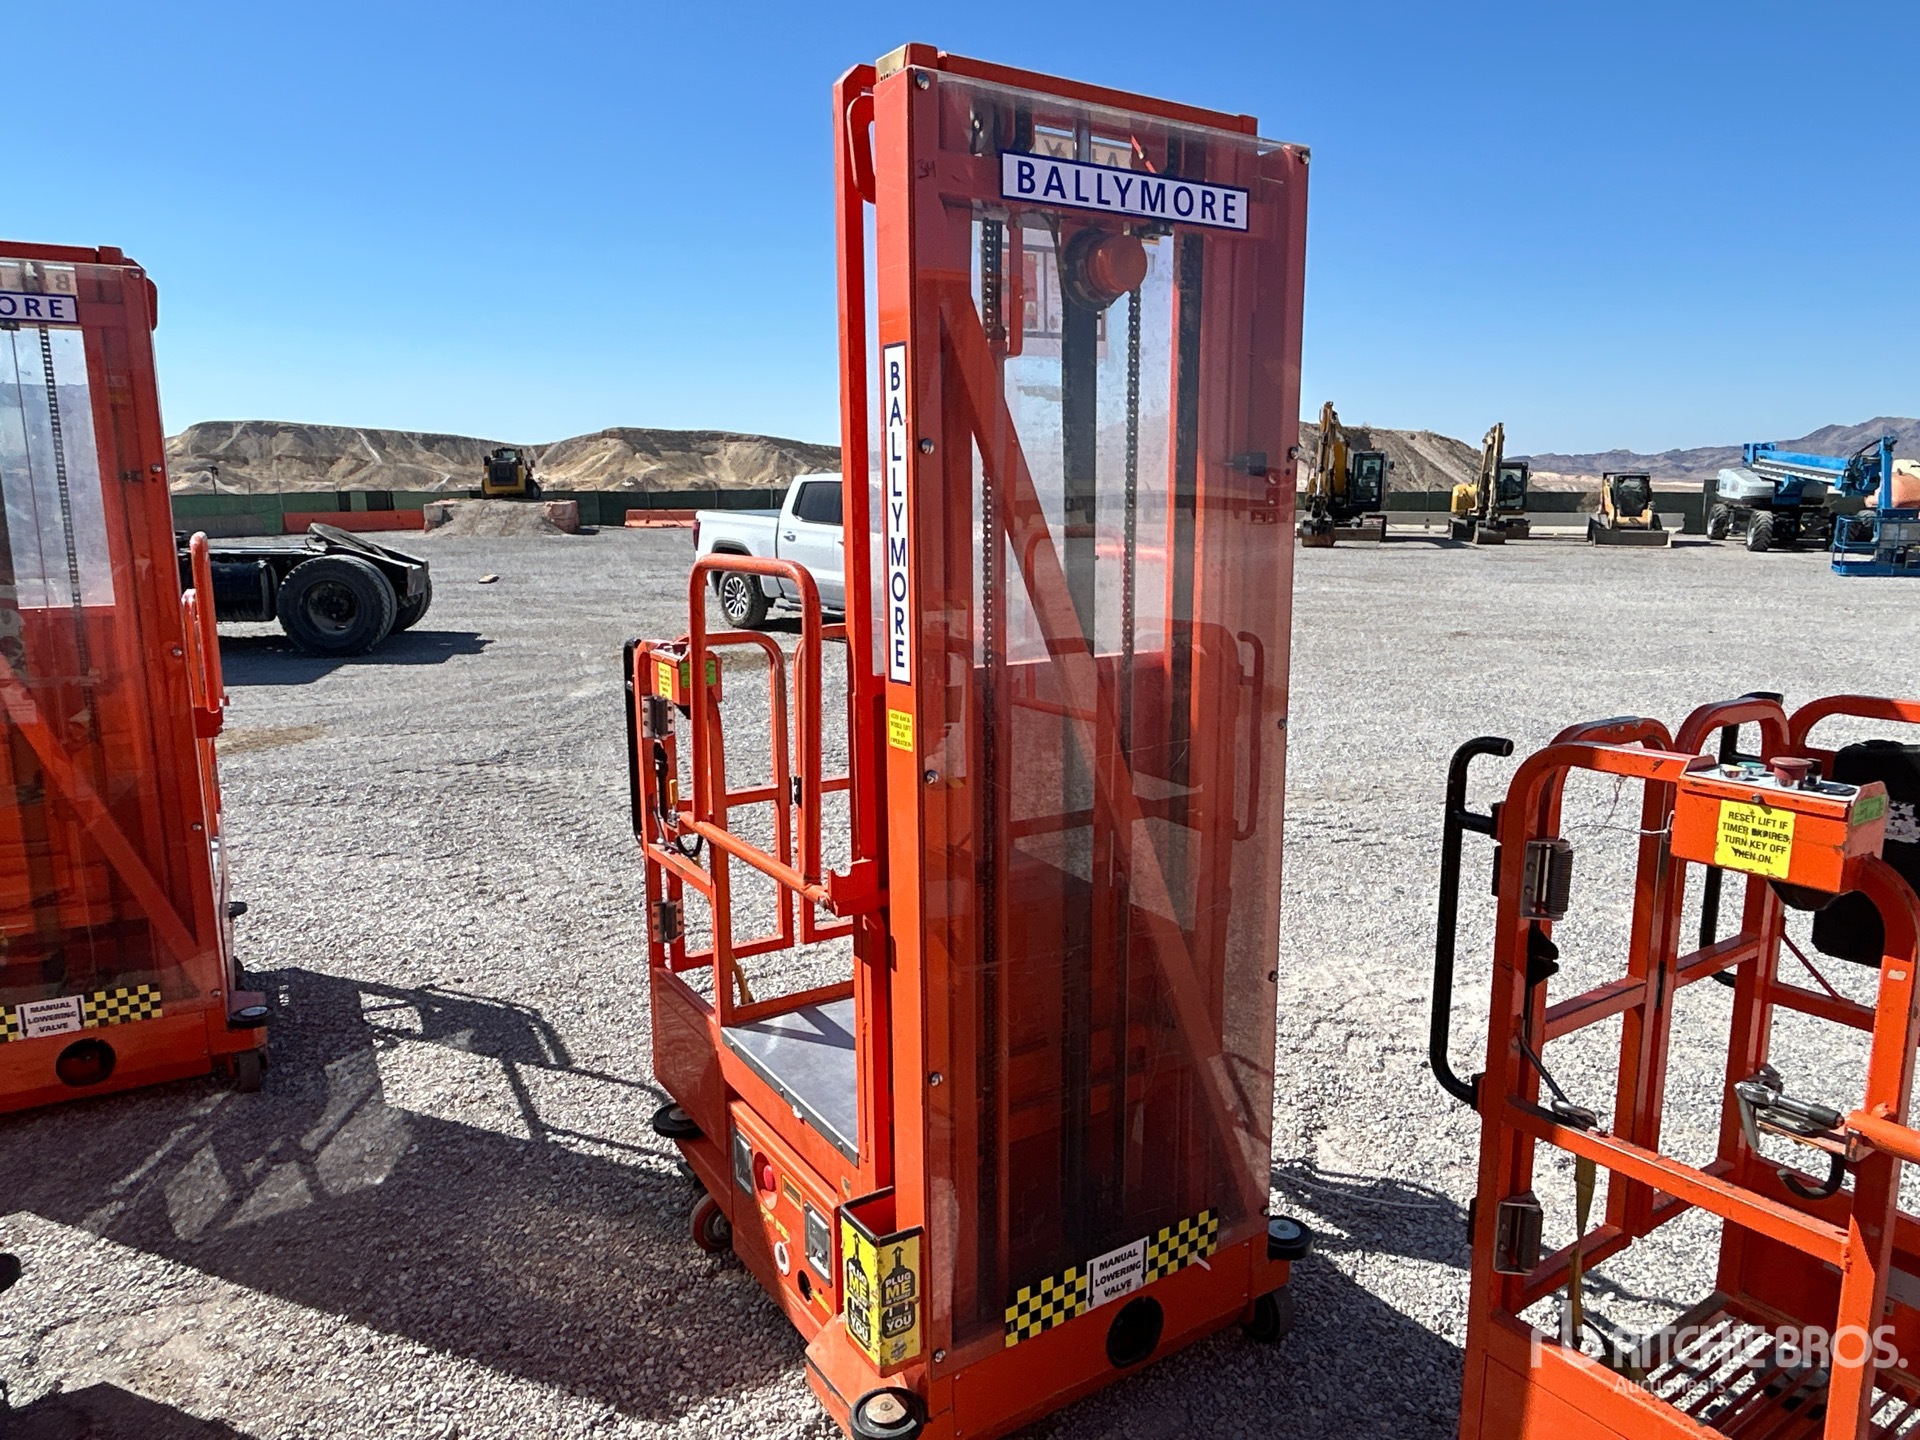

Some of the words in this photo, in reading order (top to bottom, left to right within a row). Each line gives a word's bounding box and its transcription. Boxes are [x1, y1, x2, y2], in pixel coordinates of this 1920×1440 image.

[1016, 160, 1236, 224] BALLYMORE
[0, 296, 65, 319] ORE
[889, 360, 906, 668] BALLYMORE
[1722, 821, 1749, 835] TIMER
[1728, 811, 1756, 824] RESET
[1758, 817, 1777, 828] LIFT
[1779, 821, 1788, 830] IF
[1724, 834, 1748, 847] TURN
[1749, 840, 1768, 851] KEY
[1769, 844, 1787, 855] OFF
[1758, 854, 1773, 865] ON.
[30, 1001, 72, 1013] MANUAL
[27, 1011, 77, 1025] LOWERING
[38, 1022, 69, 1033] VALVE
[1099, 1248, 1138, 1271] MANUAL
[848, 1261, 868, 1285] PLUG
[885, 1272, 911, 1287] PLUG
[1095, 1260, 1141, 1287] LOWERING
[849, 1272, 868, 1298] ME
[885, 1280, 911, 1300] ME
[1103, 1278, 1132, 1297] VALVE
[850, 1314, 869, 1341] YOU
[886, 1314, 912, 1332] YOU
